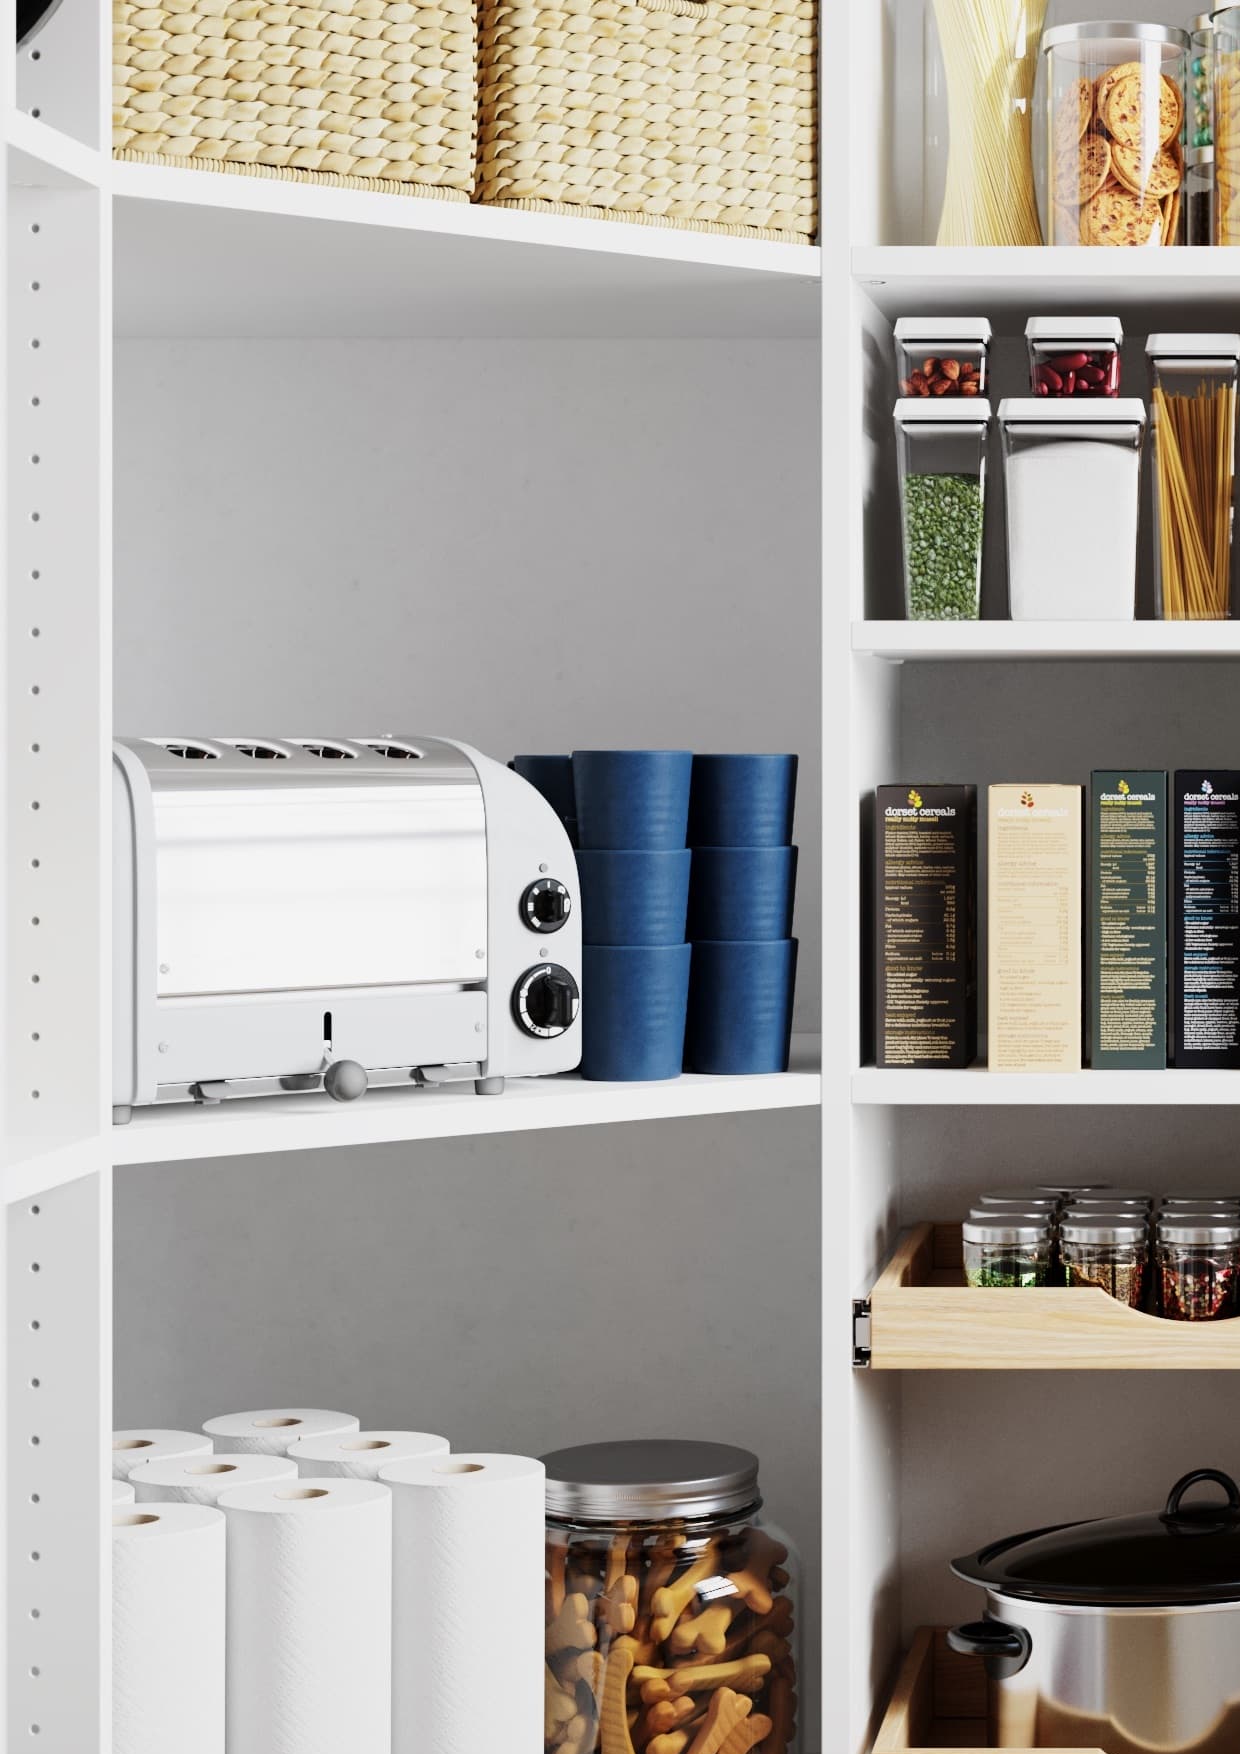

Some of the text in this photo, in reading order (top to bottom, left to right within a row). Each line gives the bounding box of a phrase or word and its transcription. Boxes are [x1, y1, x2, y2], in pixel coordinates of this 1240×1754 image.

[1100, 792, 1156, 801] dorset cereals
[1183, 792, 1239, 801] dorset cereals
[885, 807, 956, 817] dorset cereals
